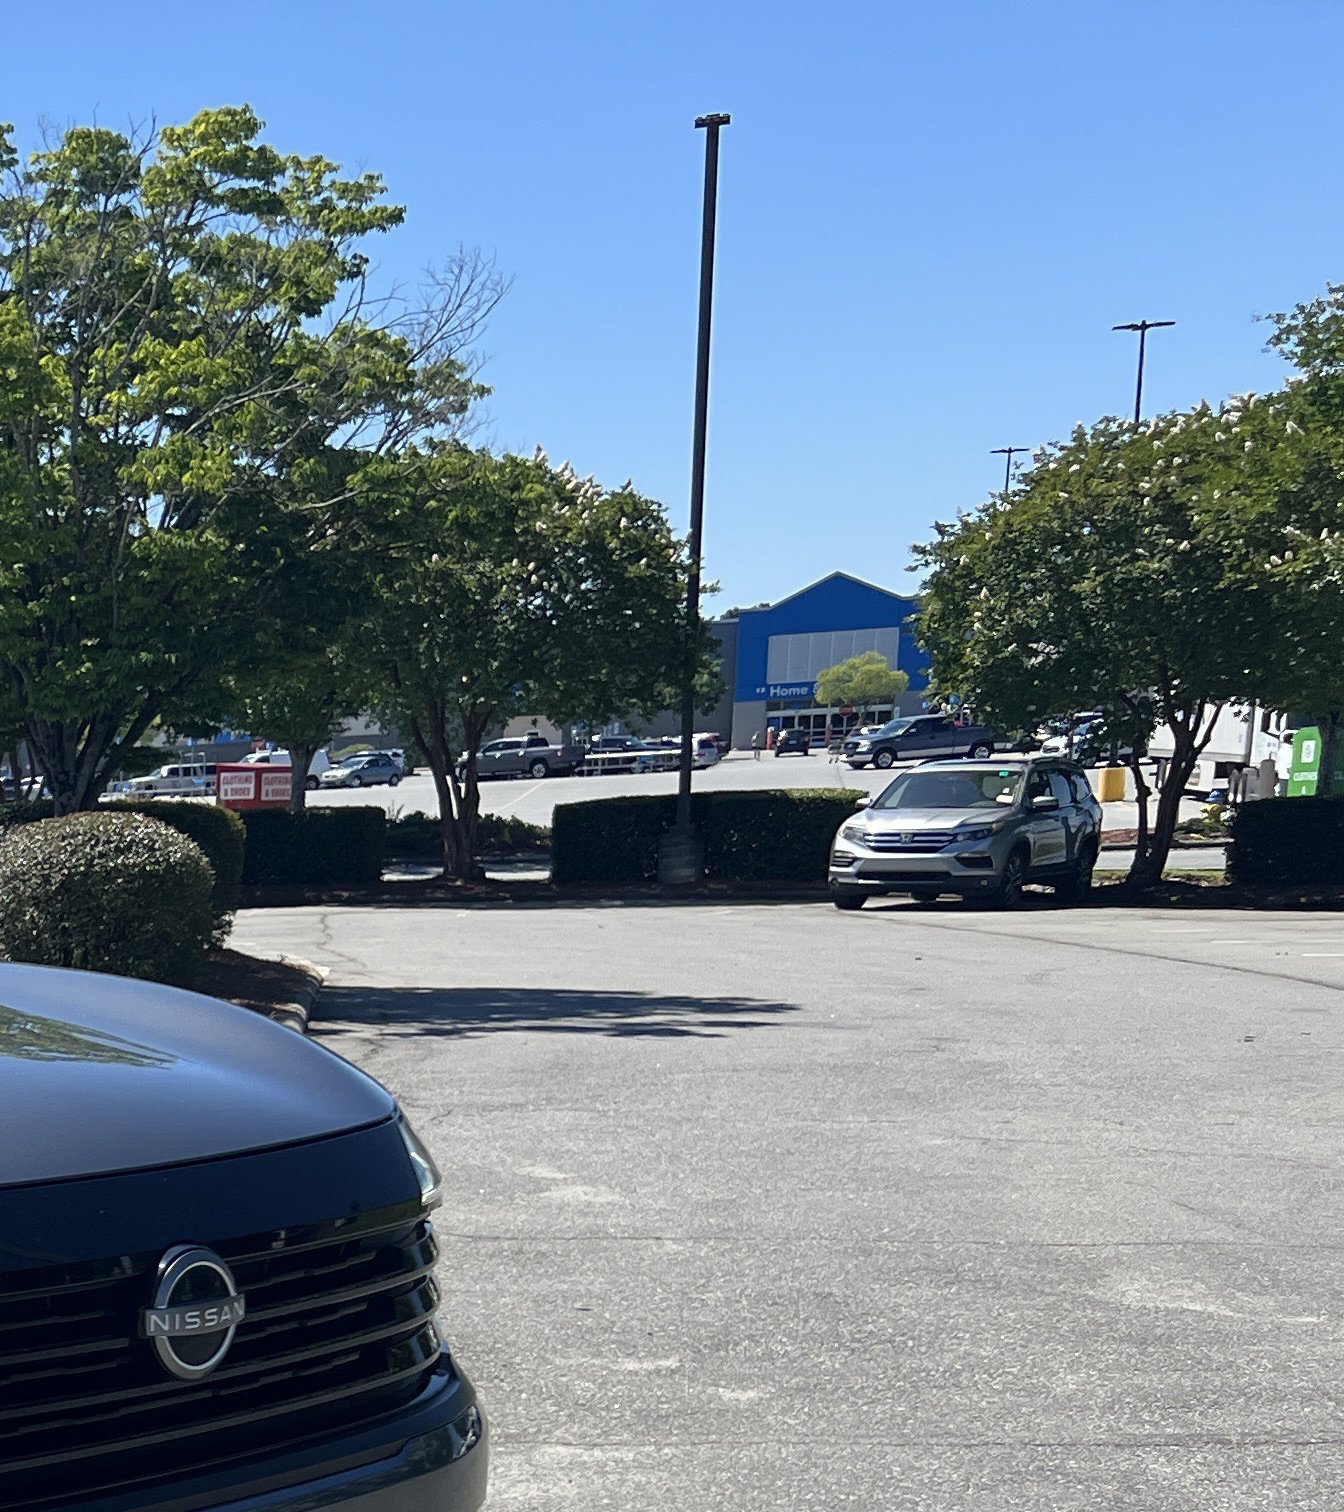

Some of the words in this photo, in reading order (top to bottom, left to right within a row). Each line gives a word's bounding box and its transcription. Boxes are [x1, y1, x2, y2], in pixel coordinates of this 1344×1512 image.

[769, 684, 809, 697] Home
[230, 787, 251, 797] SHOES
[149, 1298, 245, 1332] NISSAN
